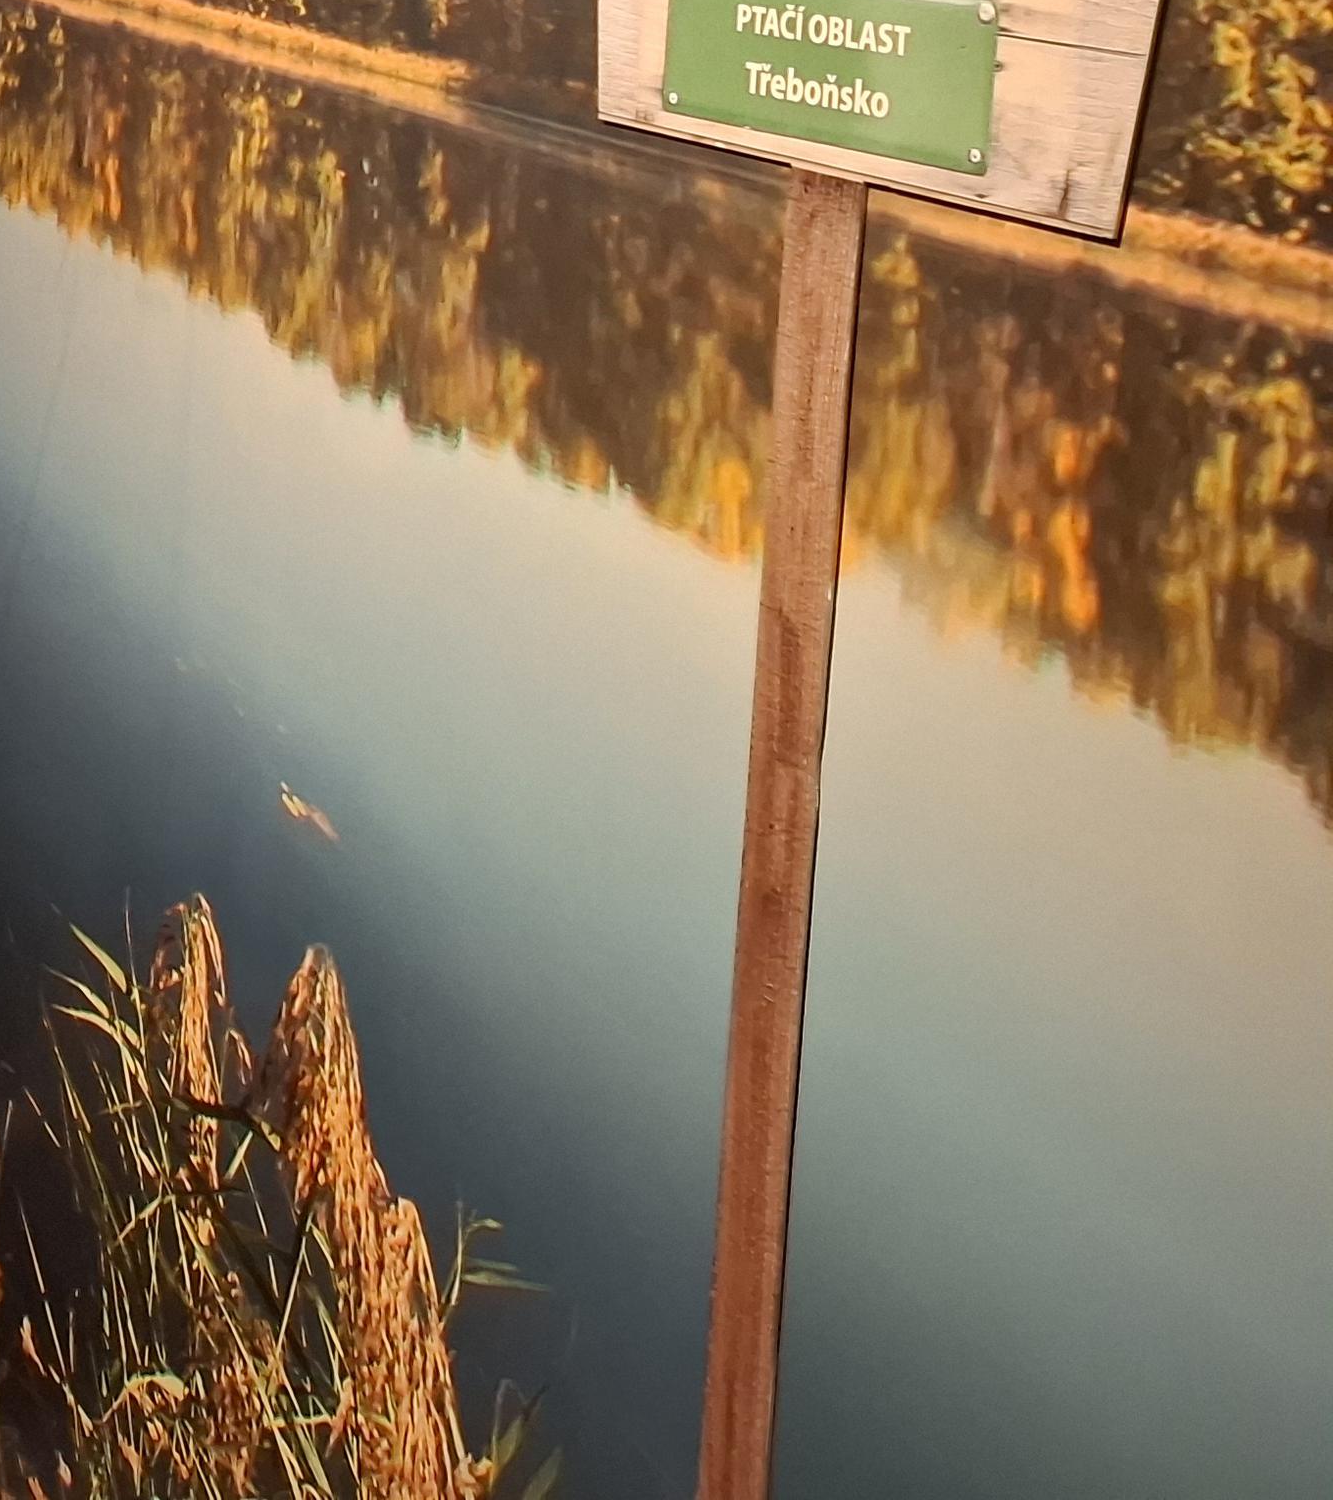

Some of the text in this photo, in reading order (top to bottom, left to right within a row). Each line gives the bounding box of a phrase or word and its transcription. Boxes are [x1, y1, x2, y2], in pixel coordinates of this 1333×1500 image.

[736, 3, 912, 57] PTAČÍ OBLAST
[745, 61, 889, 118] Třeboňsko
